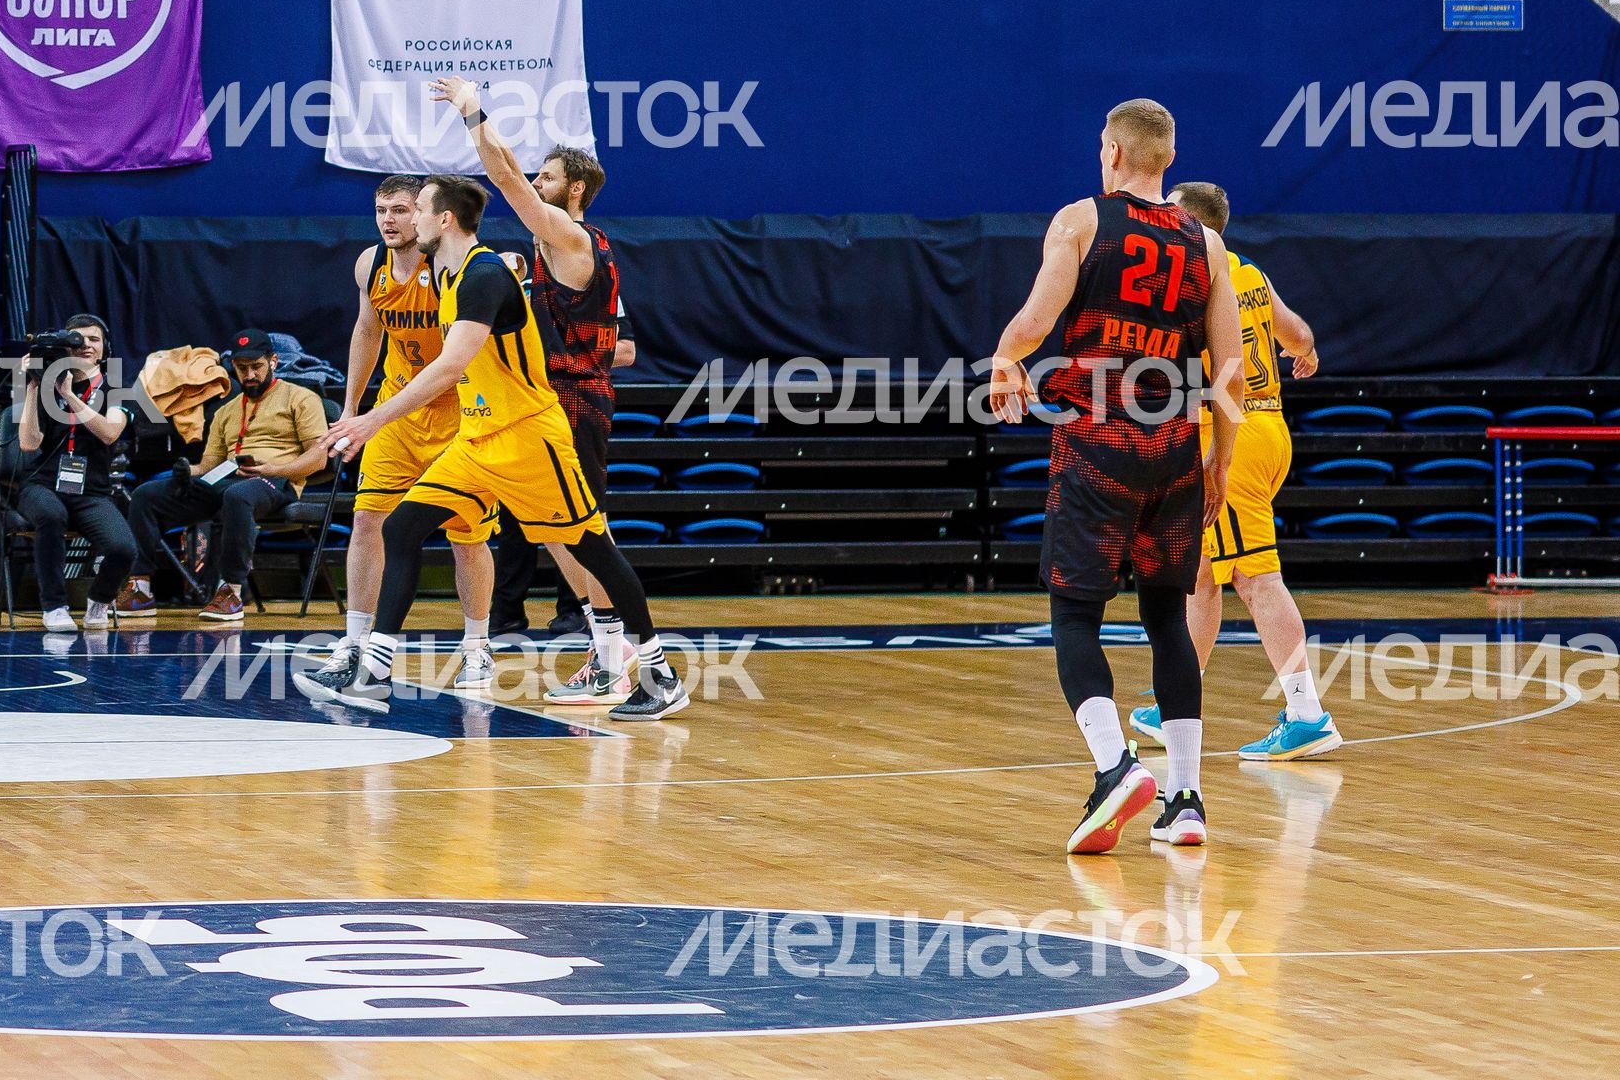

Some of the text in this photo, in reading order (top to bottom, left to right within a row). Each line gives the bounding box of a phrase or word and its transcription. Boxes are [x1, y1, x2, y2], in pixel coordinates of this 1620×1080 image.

[31, 28, 116, 47] ЛИГА
[405, 37, 513, 51] РОССИЙСКАЯ
[368, 57, 553, 73] ФЕДЕРАЦИЯ БАСКЕТБОЛА
[1120, 233, 1186, 312] 21
[102, 913, 726, 1021] РФБ
